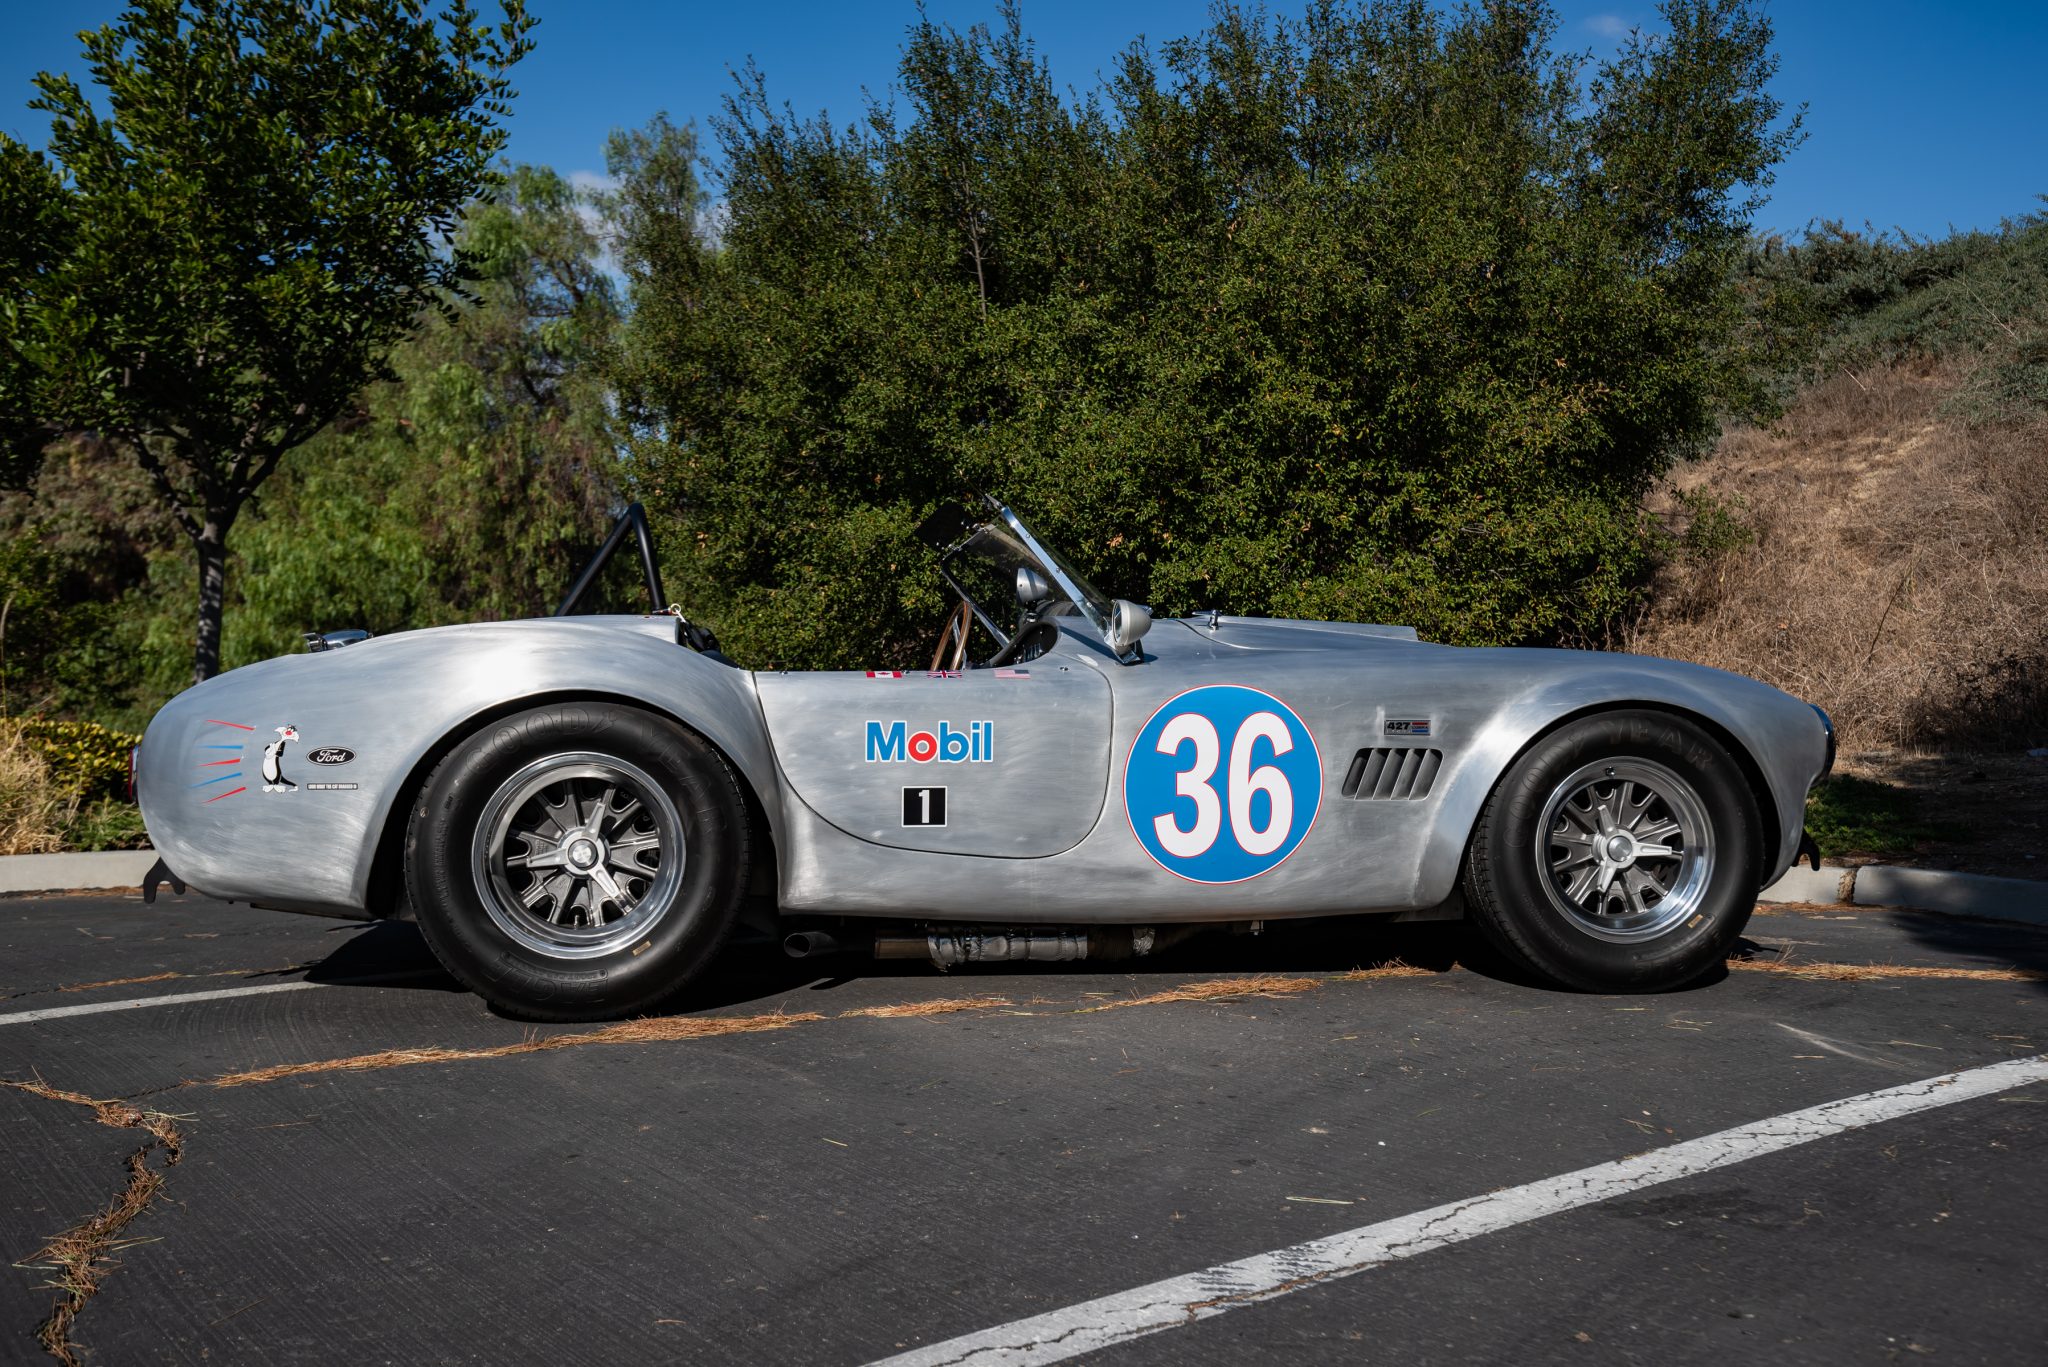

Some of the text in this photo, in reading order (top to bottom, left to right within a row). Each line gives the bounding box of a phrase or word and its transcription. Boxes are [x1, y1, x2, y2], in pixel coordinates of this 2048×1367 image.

[865, 720, 993, 763] Mobil
[1387, 721, 1410, 730] 427
[316, 749, 346, 763] Ford
[1153, 711, 1294, 858] 36
[918, 789, 930, 824] 1
